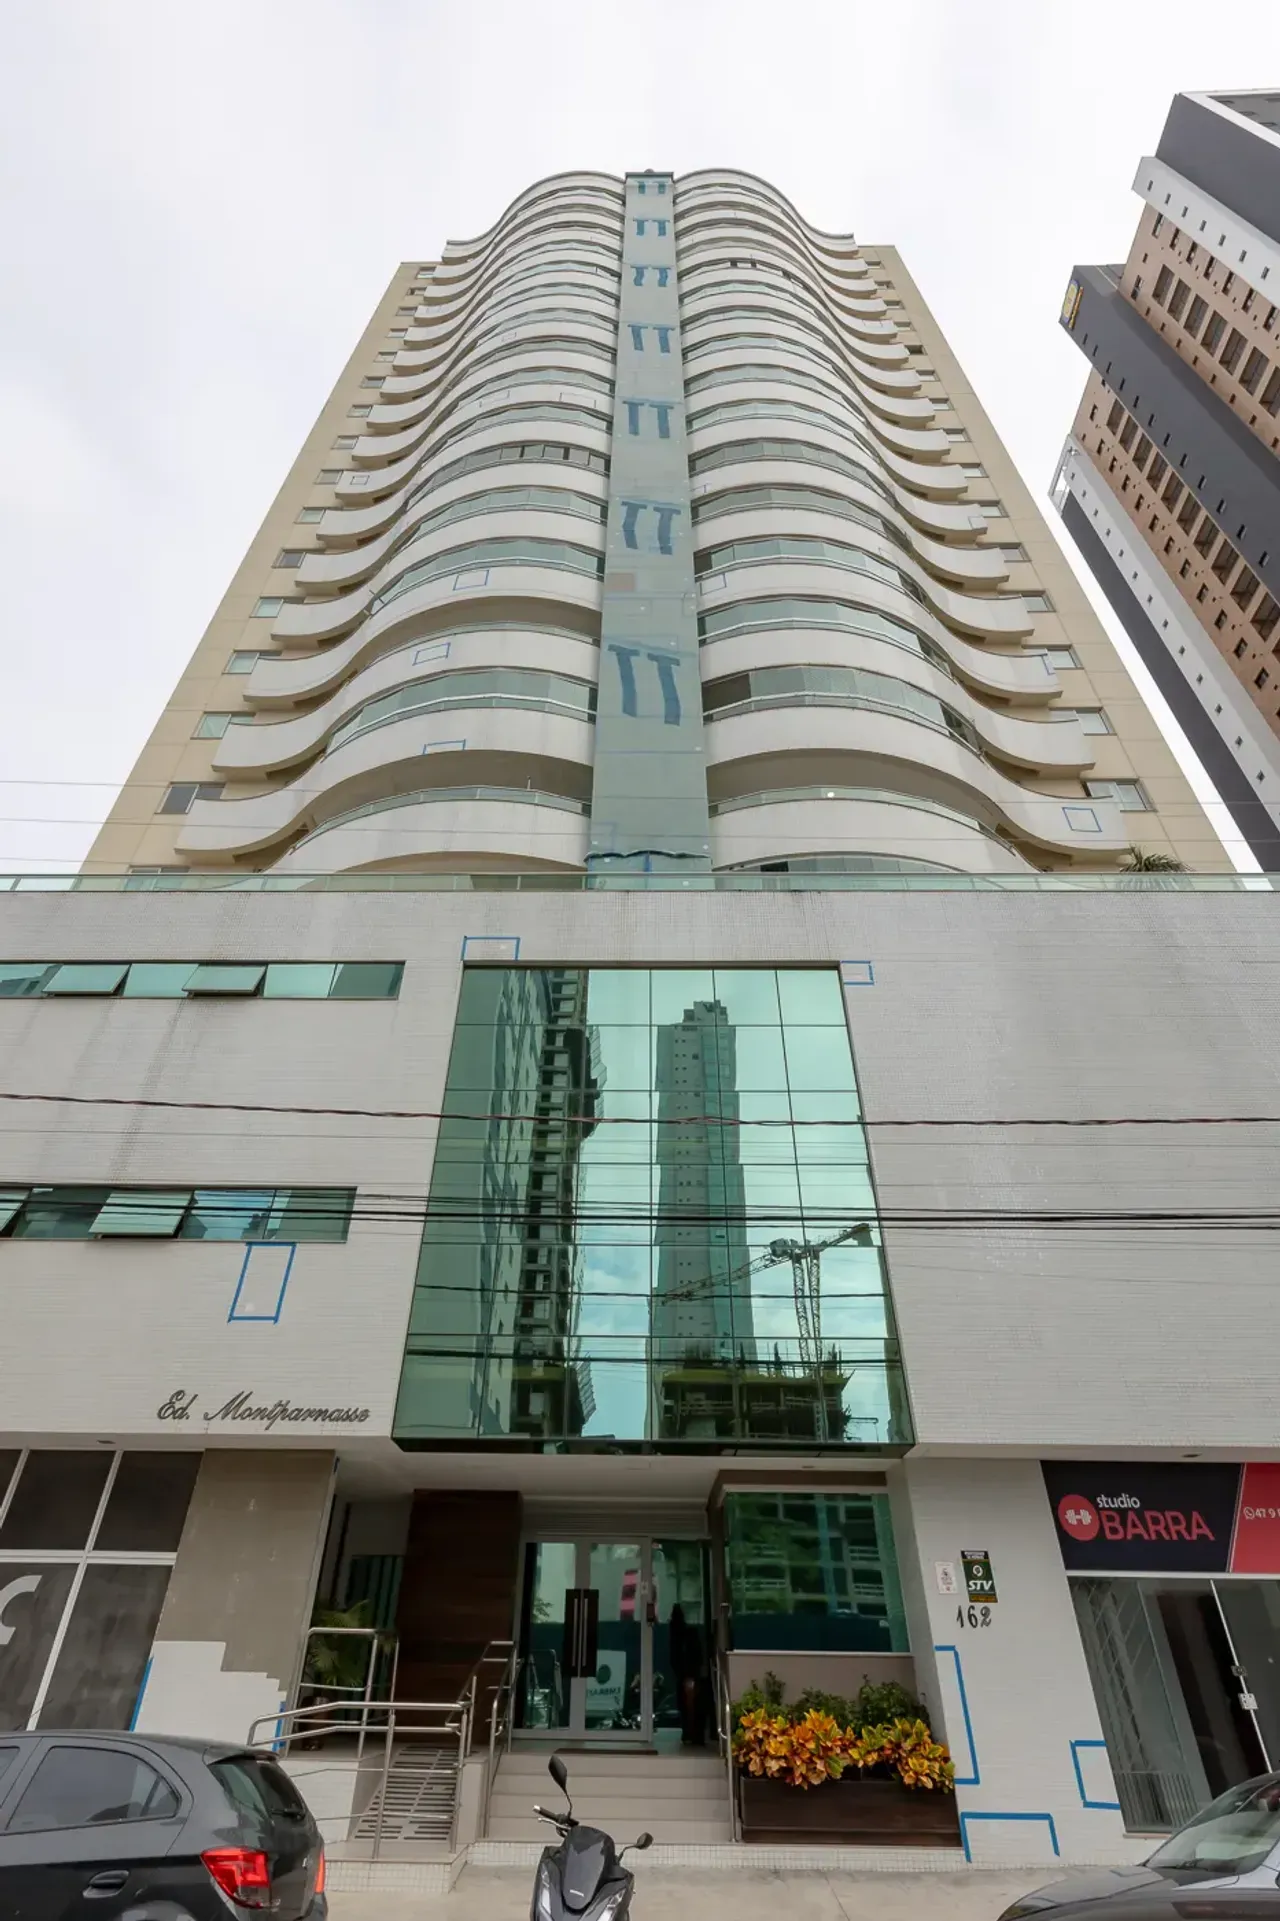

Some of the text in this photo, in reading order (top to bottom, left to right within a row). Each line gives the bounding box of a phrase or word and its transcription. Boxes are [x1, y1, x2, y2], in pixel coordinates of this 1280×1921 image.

[157, 1389, 371, 1431] Ed. Montparnasse
[1096, 1493, 1140, 1508] studio
[1100, 1511, 1215, 1541] BARRA
[968, 1580, 992, 1591] STV
[956, 1605, 992, 1628] 162
